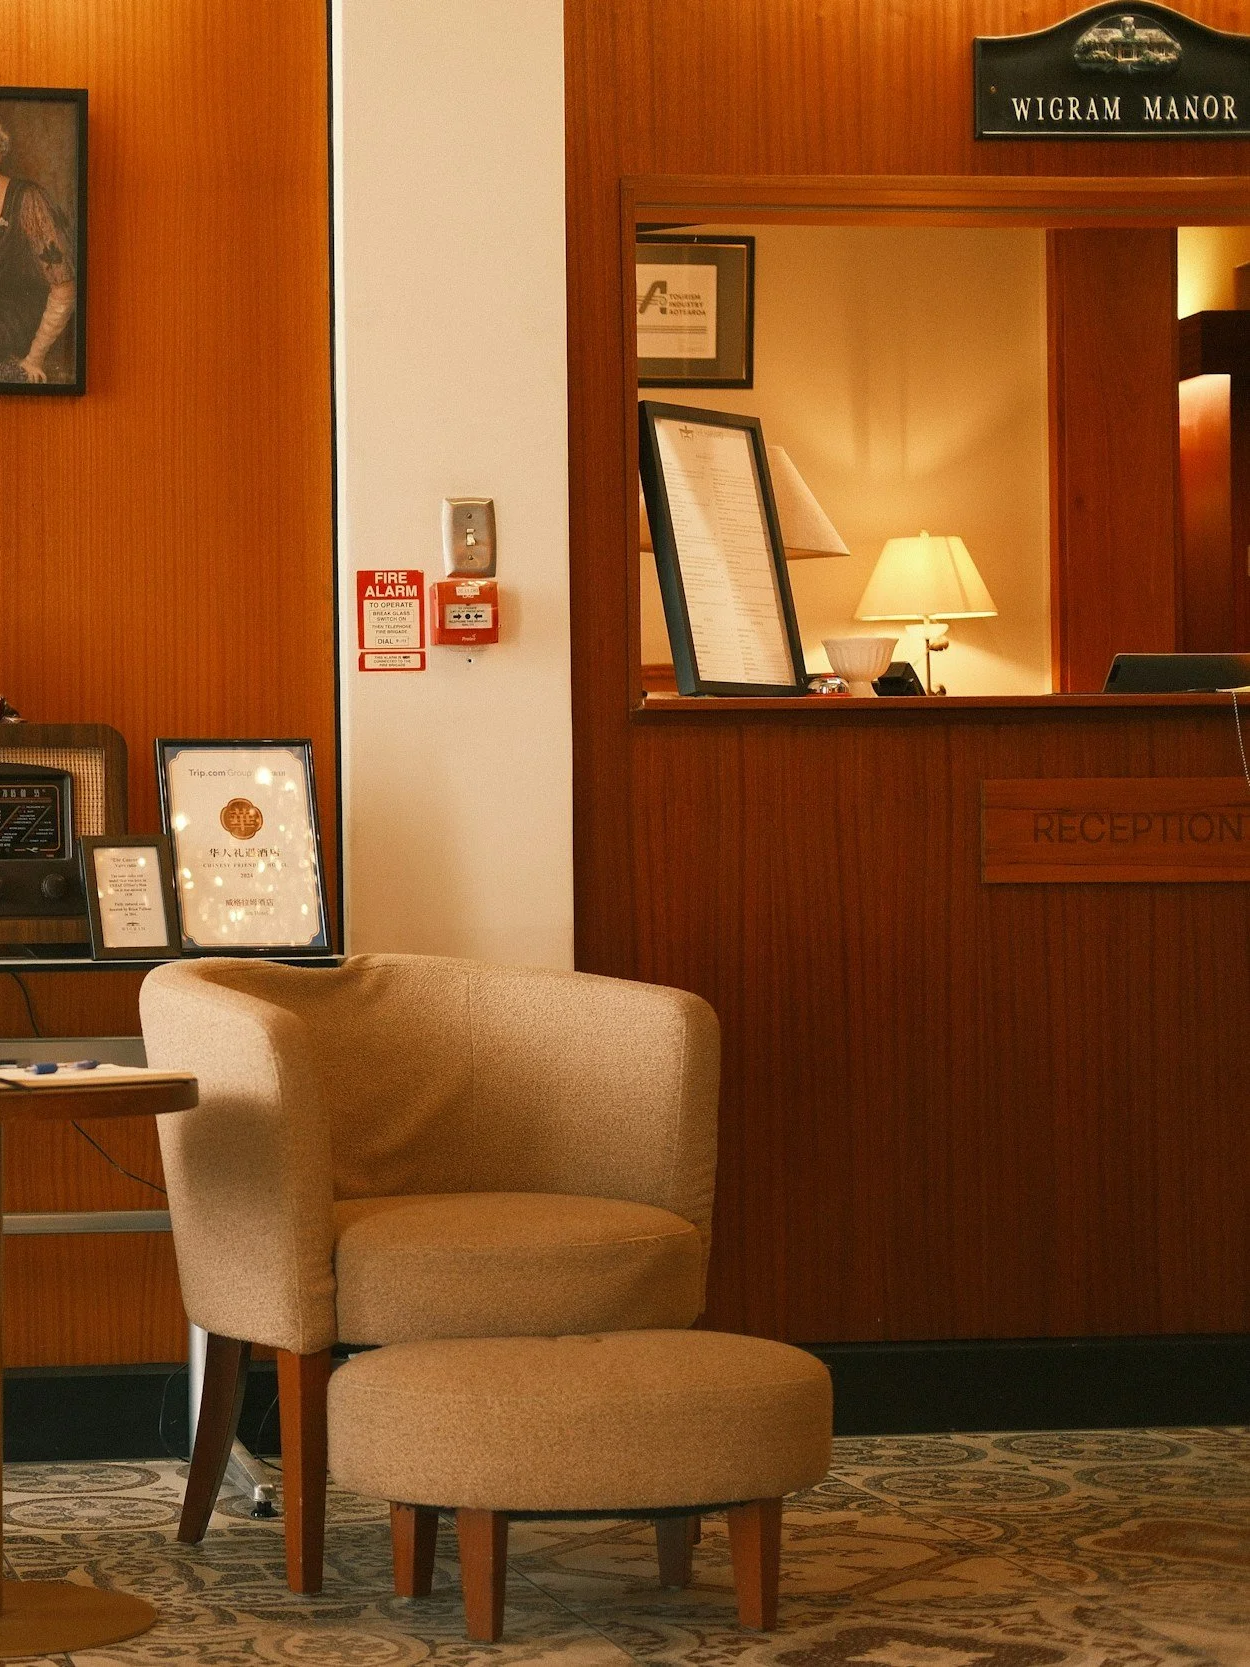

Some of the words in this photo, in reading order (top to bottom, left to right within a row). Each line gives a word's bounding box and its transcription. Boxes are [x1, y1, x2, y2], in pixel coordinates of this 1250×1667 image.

[1011, 96, 1121, 121] WIGRAM
[1144, 94, 1238, 120] MANOR
[374, 571, 408, 584] FIRE
[364, 585, 418, 597] ALARM
[188, 768, 226, 778] Trip.com
[227, 768, 252, 778] Group
[1033, 811, 1243, 844] RECEPTION
